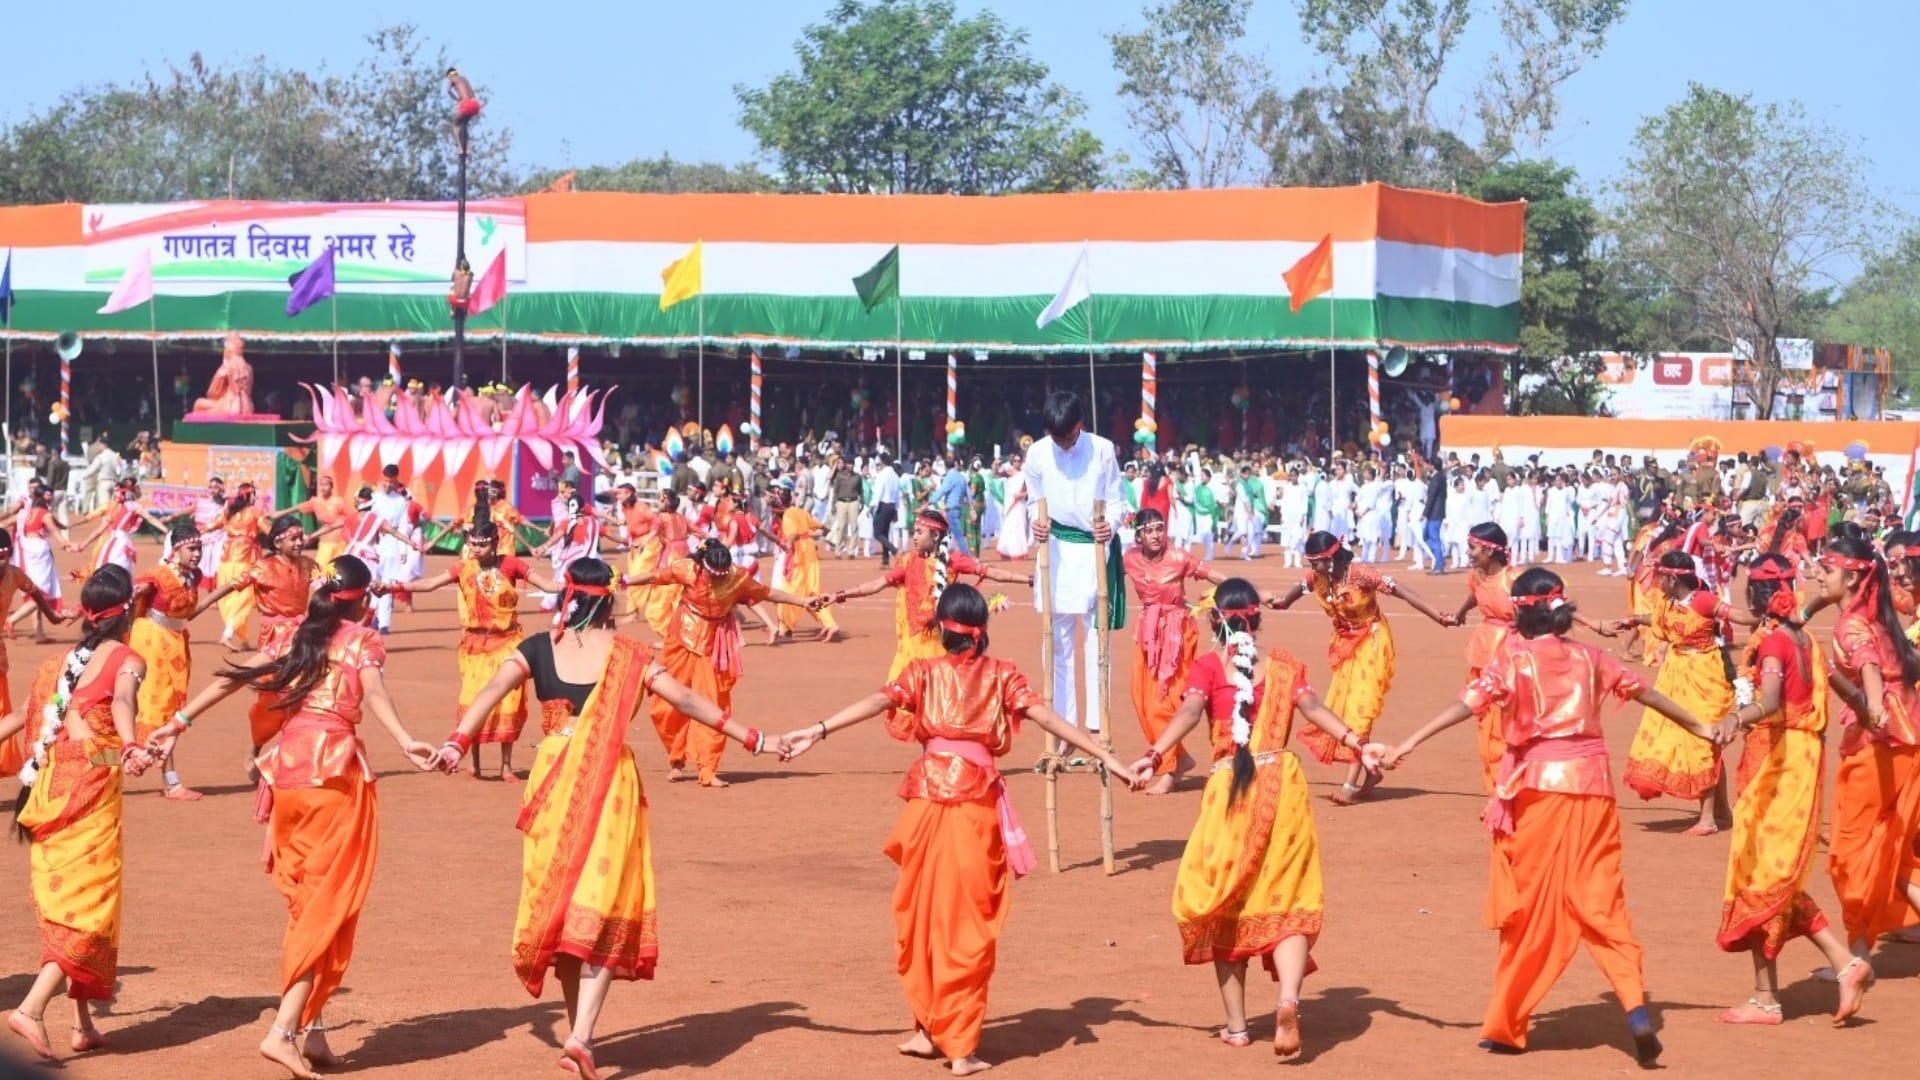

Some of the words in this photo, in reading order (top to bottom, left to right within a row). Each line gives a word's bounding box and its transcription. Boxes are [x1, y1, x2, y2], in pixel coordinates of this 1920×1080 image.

[163, 223, 237, 258] गणतंत्र
[248, 223, 311, 261] दिवस
[324, 234, 376, 260] अमर
[387, 223, 416, 262] रहे
